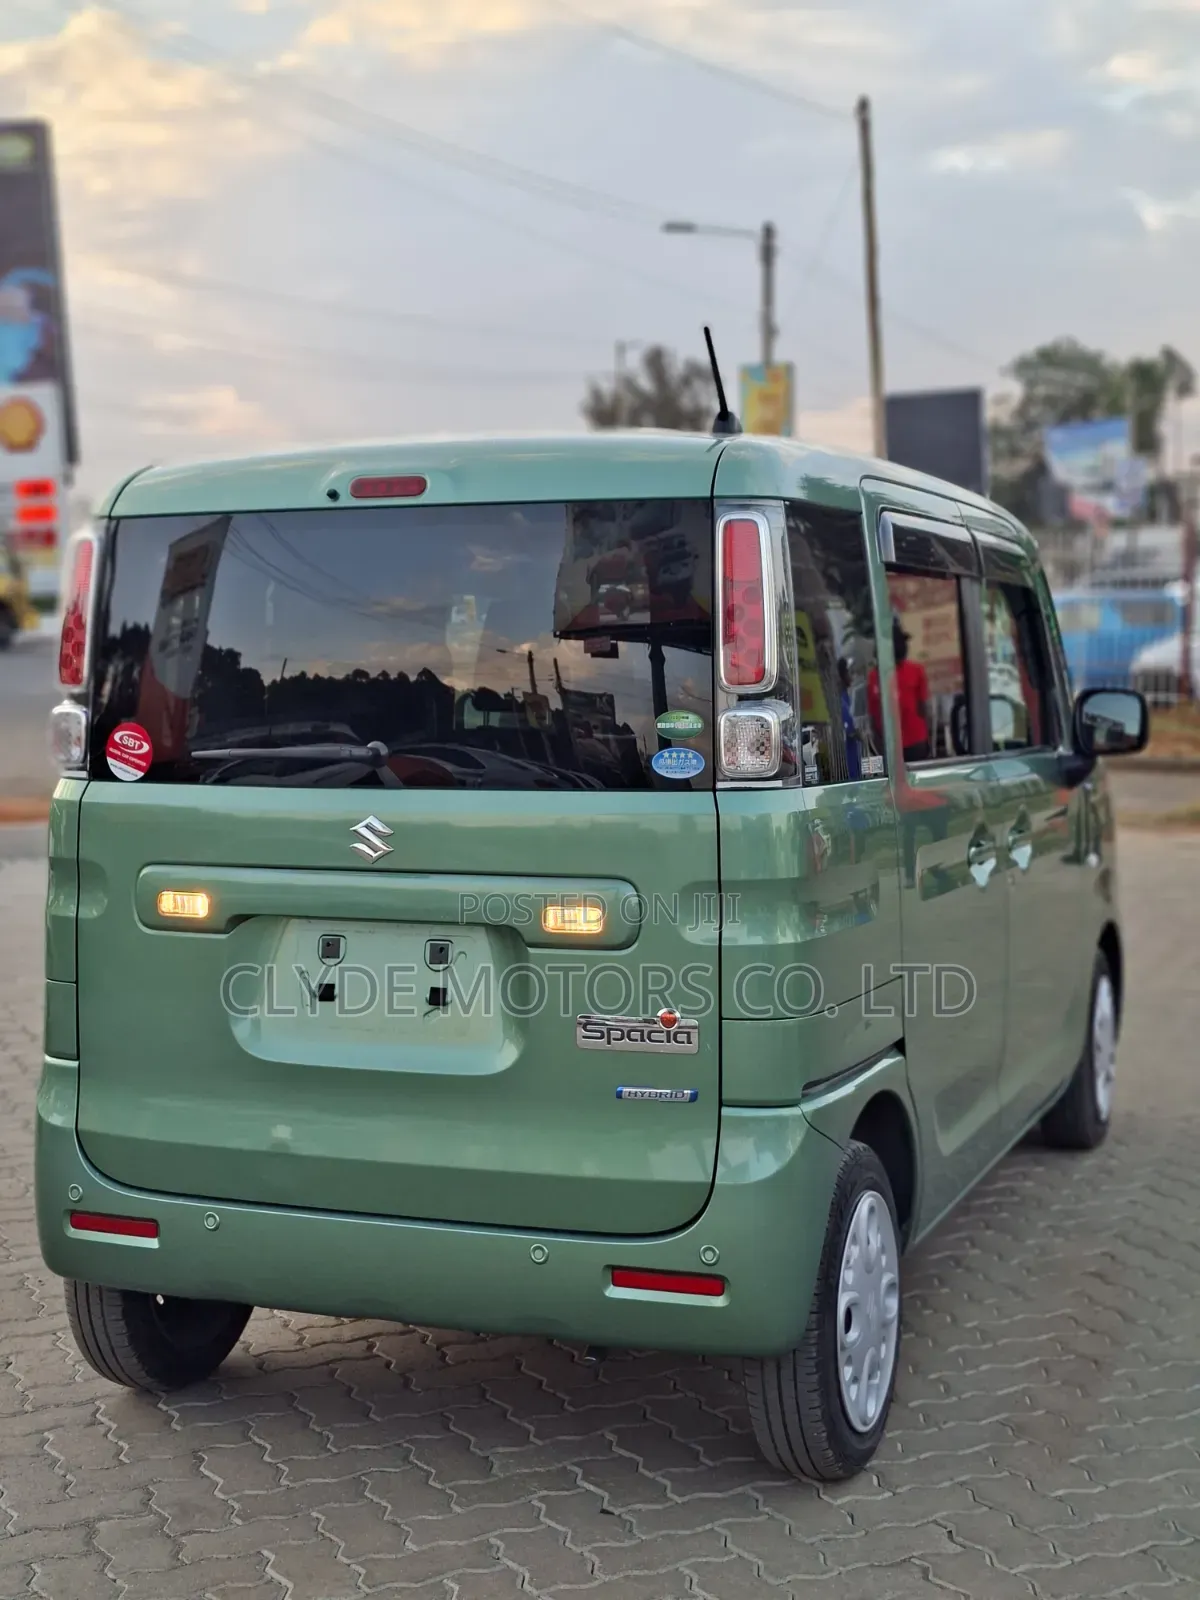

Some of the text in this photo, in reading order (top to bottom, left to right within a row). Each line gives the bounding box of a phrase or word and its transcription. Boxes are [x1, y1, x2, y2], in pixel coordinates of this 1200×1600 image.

[122, 735, 141, 750] SBT
[582, 1021, 692, 1045] Spacia
[627, 1090, 685, 1099] HYBRID
